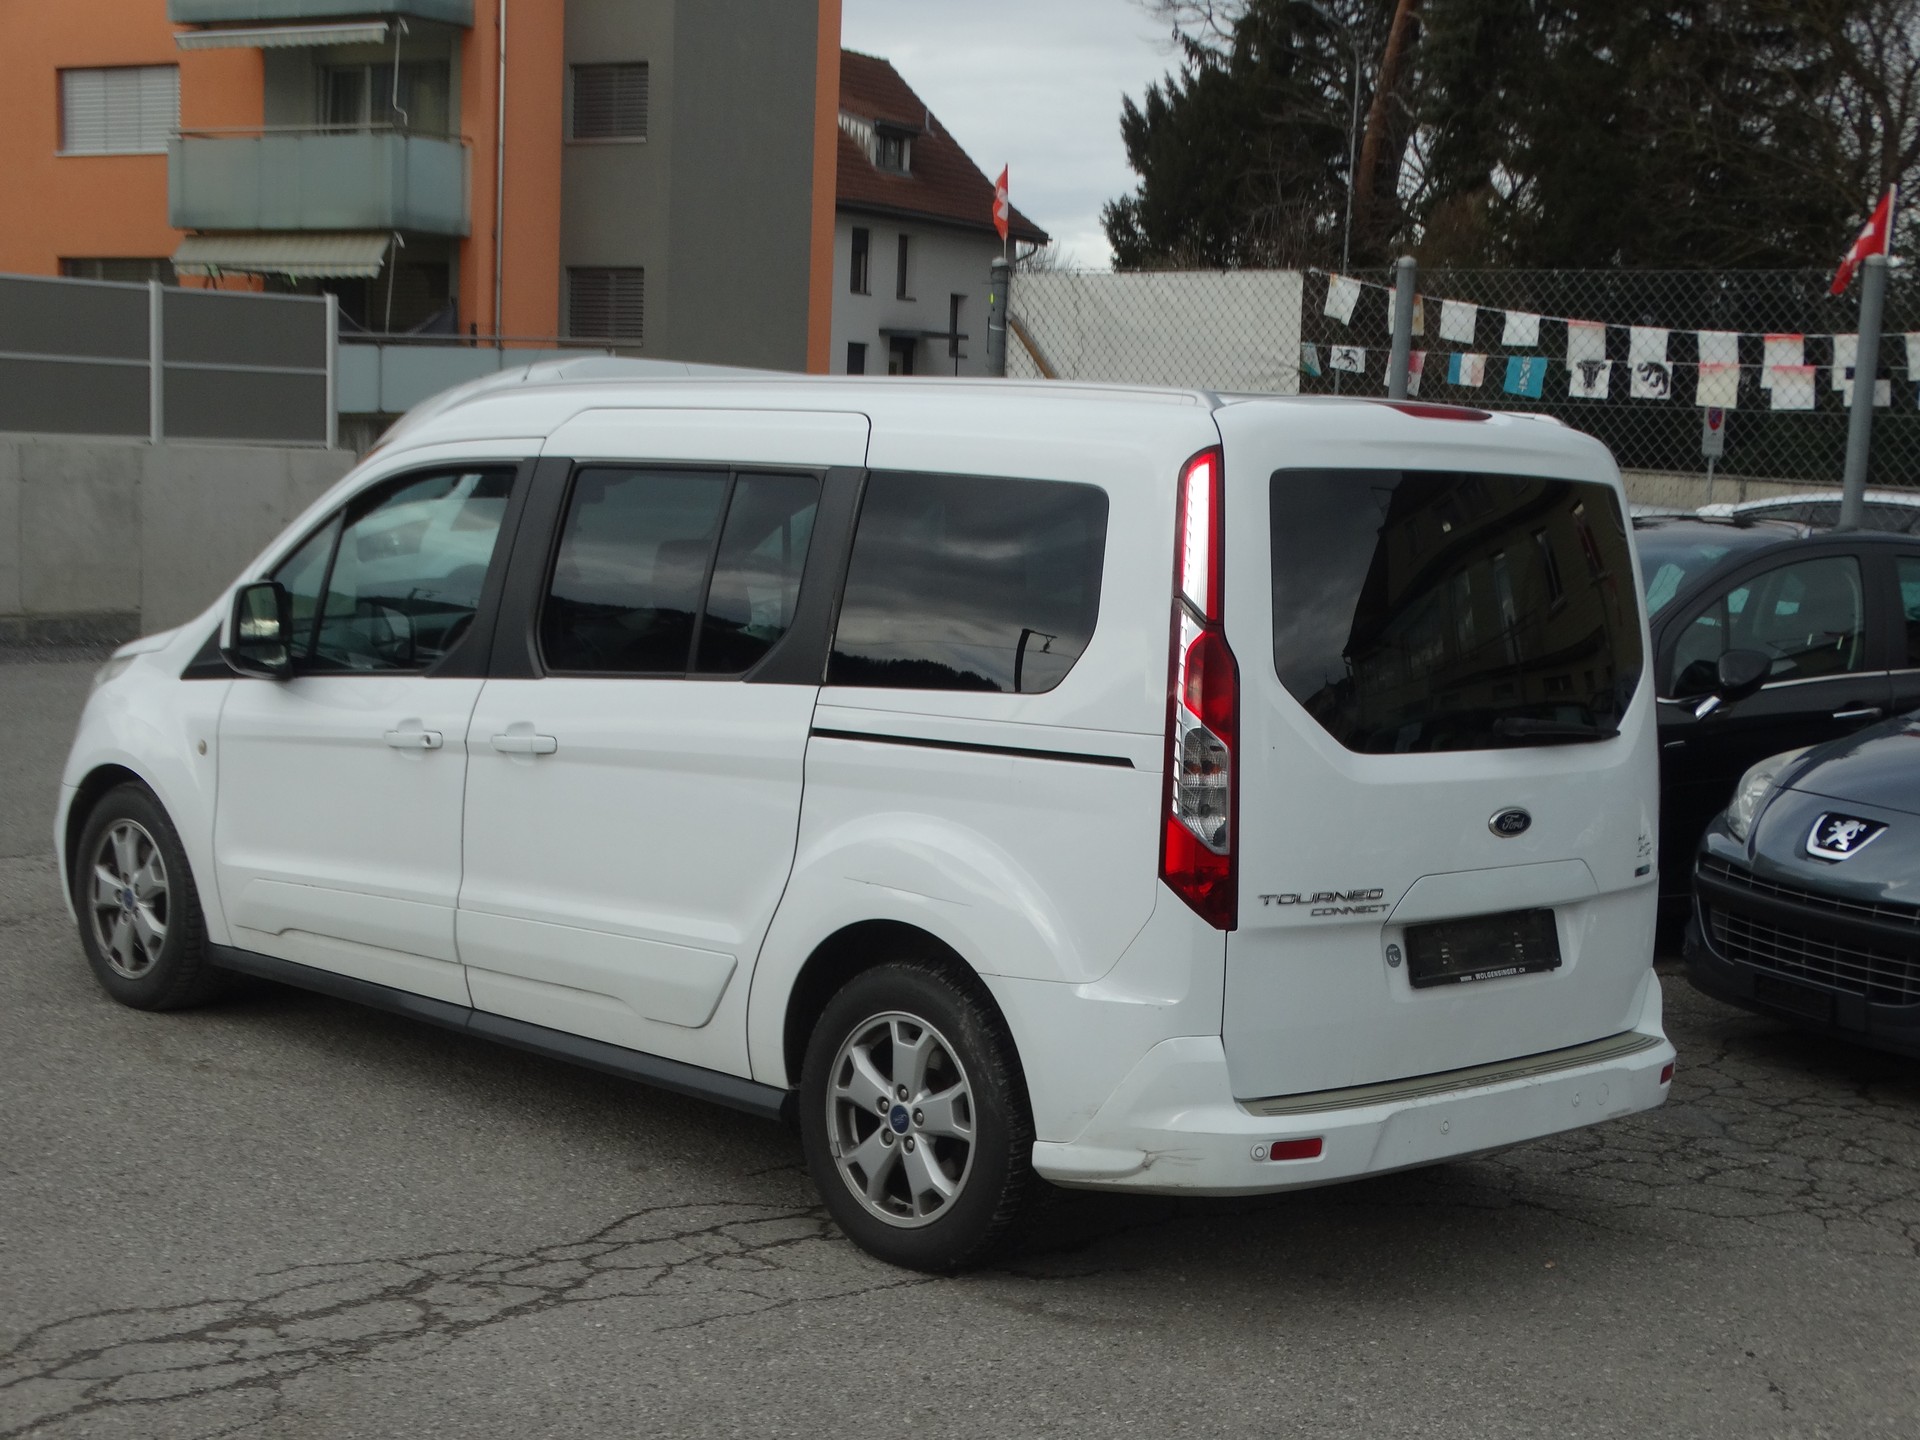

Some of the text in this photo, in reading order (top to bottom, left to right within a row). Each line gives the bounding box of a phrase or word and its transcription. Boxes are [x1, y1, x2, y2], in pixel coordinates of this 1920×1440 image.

[1502, 814, 1525, 830] Ford
[1258, 888, 1384, 906] TOURNEO
[1310, 903, 1390, 917] CONNECT
